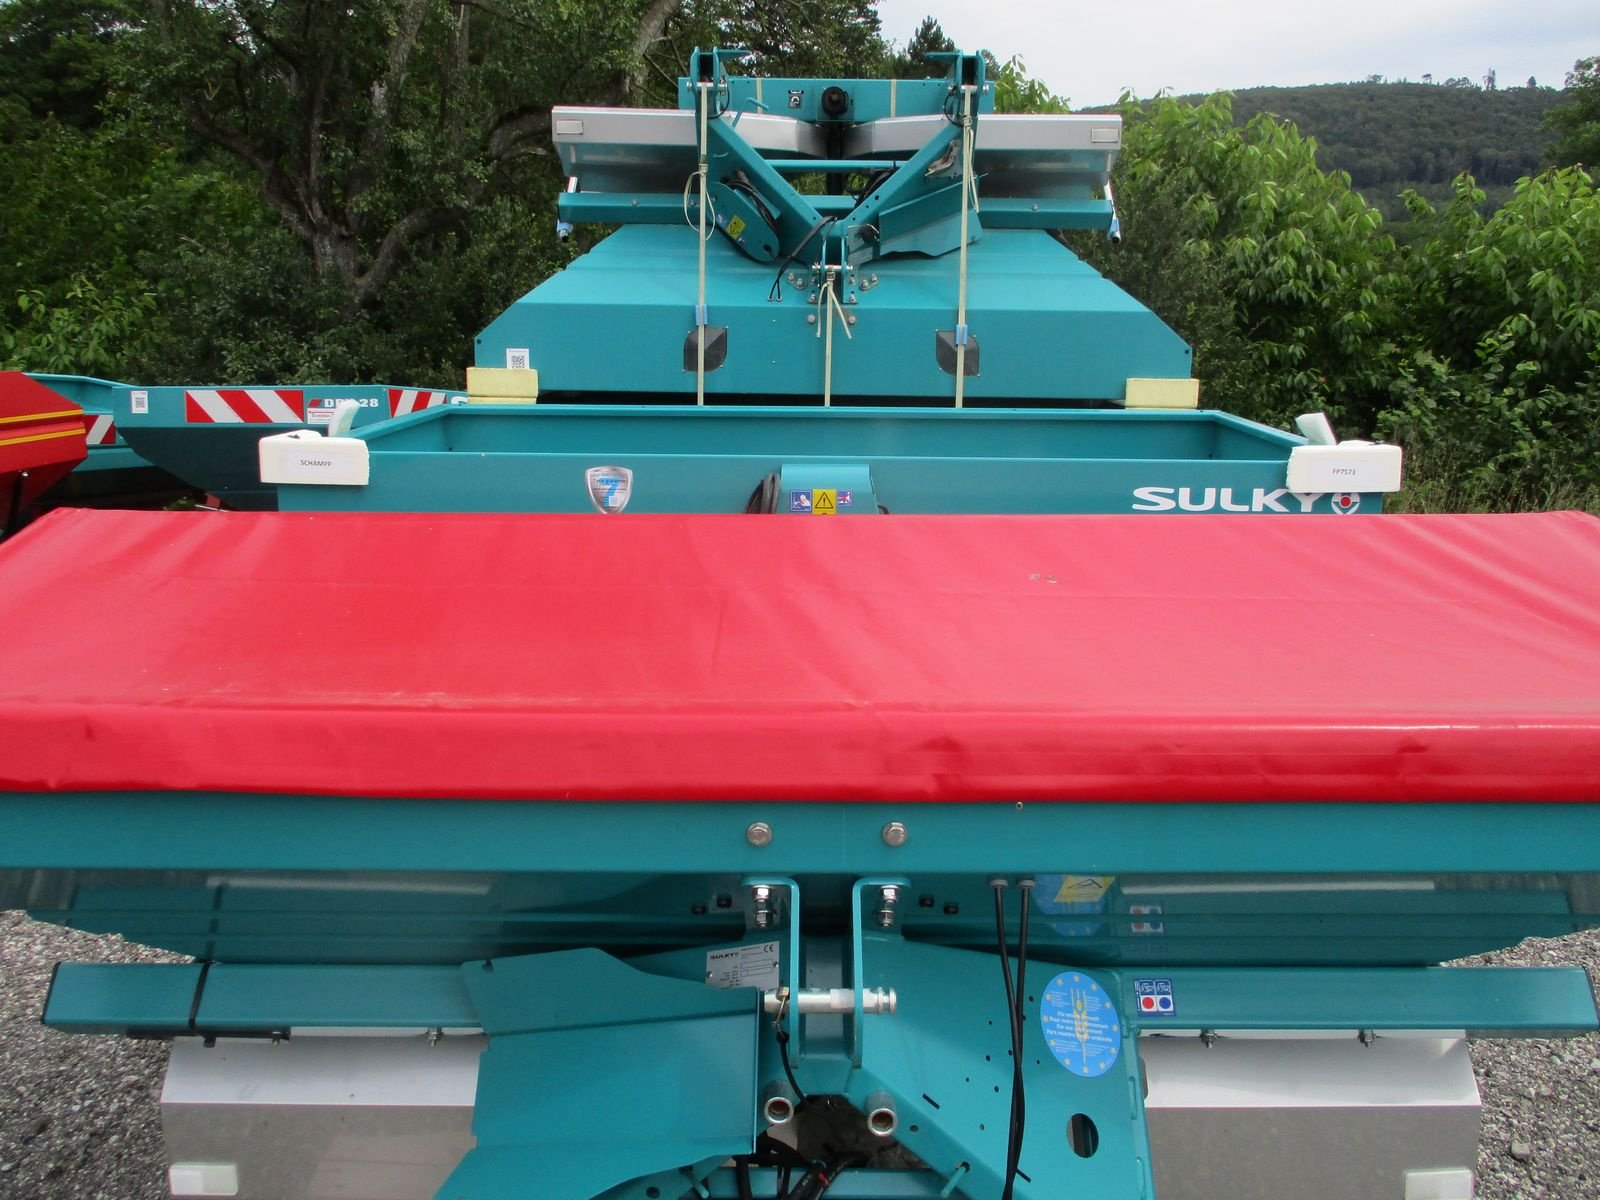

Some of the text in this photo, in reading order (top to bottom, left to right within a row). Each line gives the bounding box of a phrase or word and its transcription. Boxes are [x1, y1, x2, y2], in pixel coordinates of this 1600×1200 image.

[359, 399, 379, 407] 28
[300, 459, 332, 467] SCHAMPP
[1131, 486, 1327, 513] SULKY
[710, 951, 736, 960] SULKY
